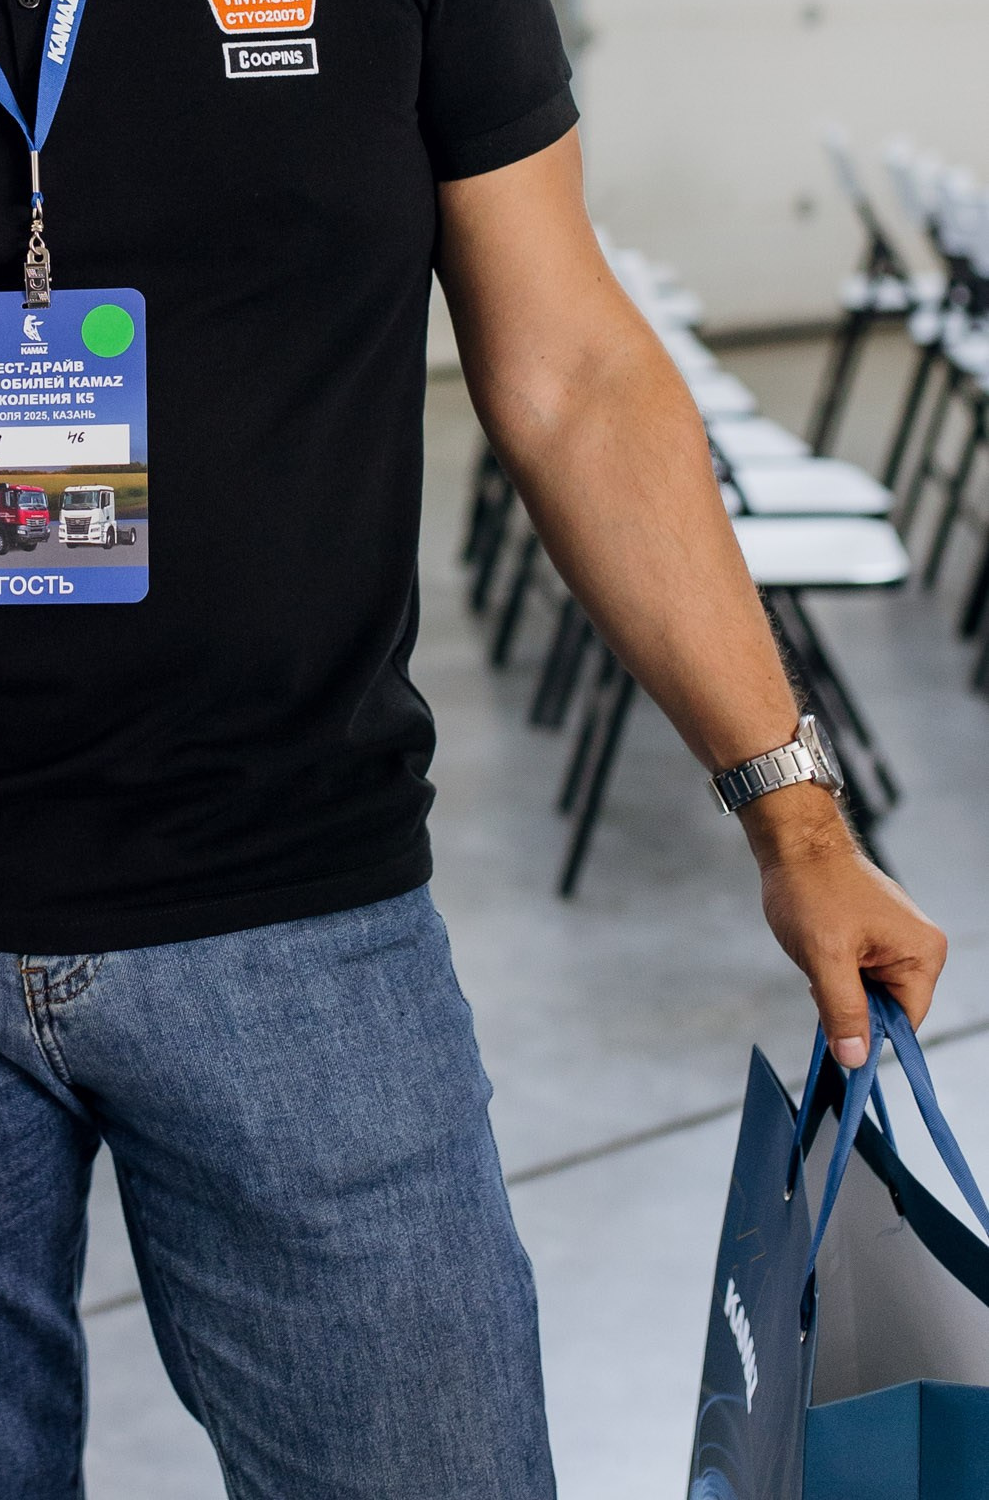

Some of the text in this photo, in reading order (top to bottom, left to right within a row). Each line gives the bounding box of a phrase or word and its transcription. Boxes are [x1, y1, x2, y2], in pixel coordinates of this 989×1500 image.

[20, 346, 48, 355] KAMAZ
[69, 376, 123, 388] KAMAZ
[24, 411, 50, 421] 2025,
[53, 410, 96, 420] КАЗАНЬ
